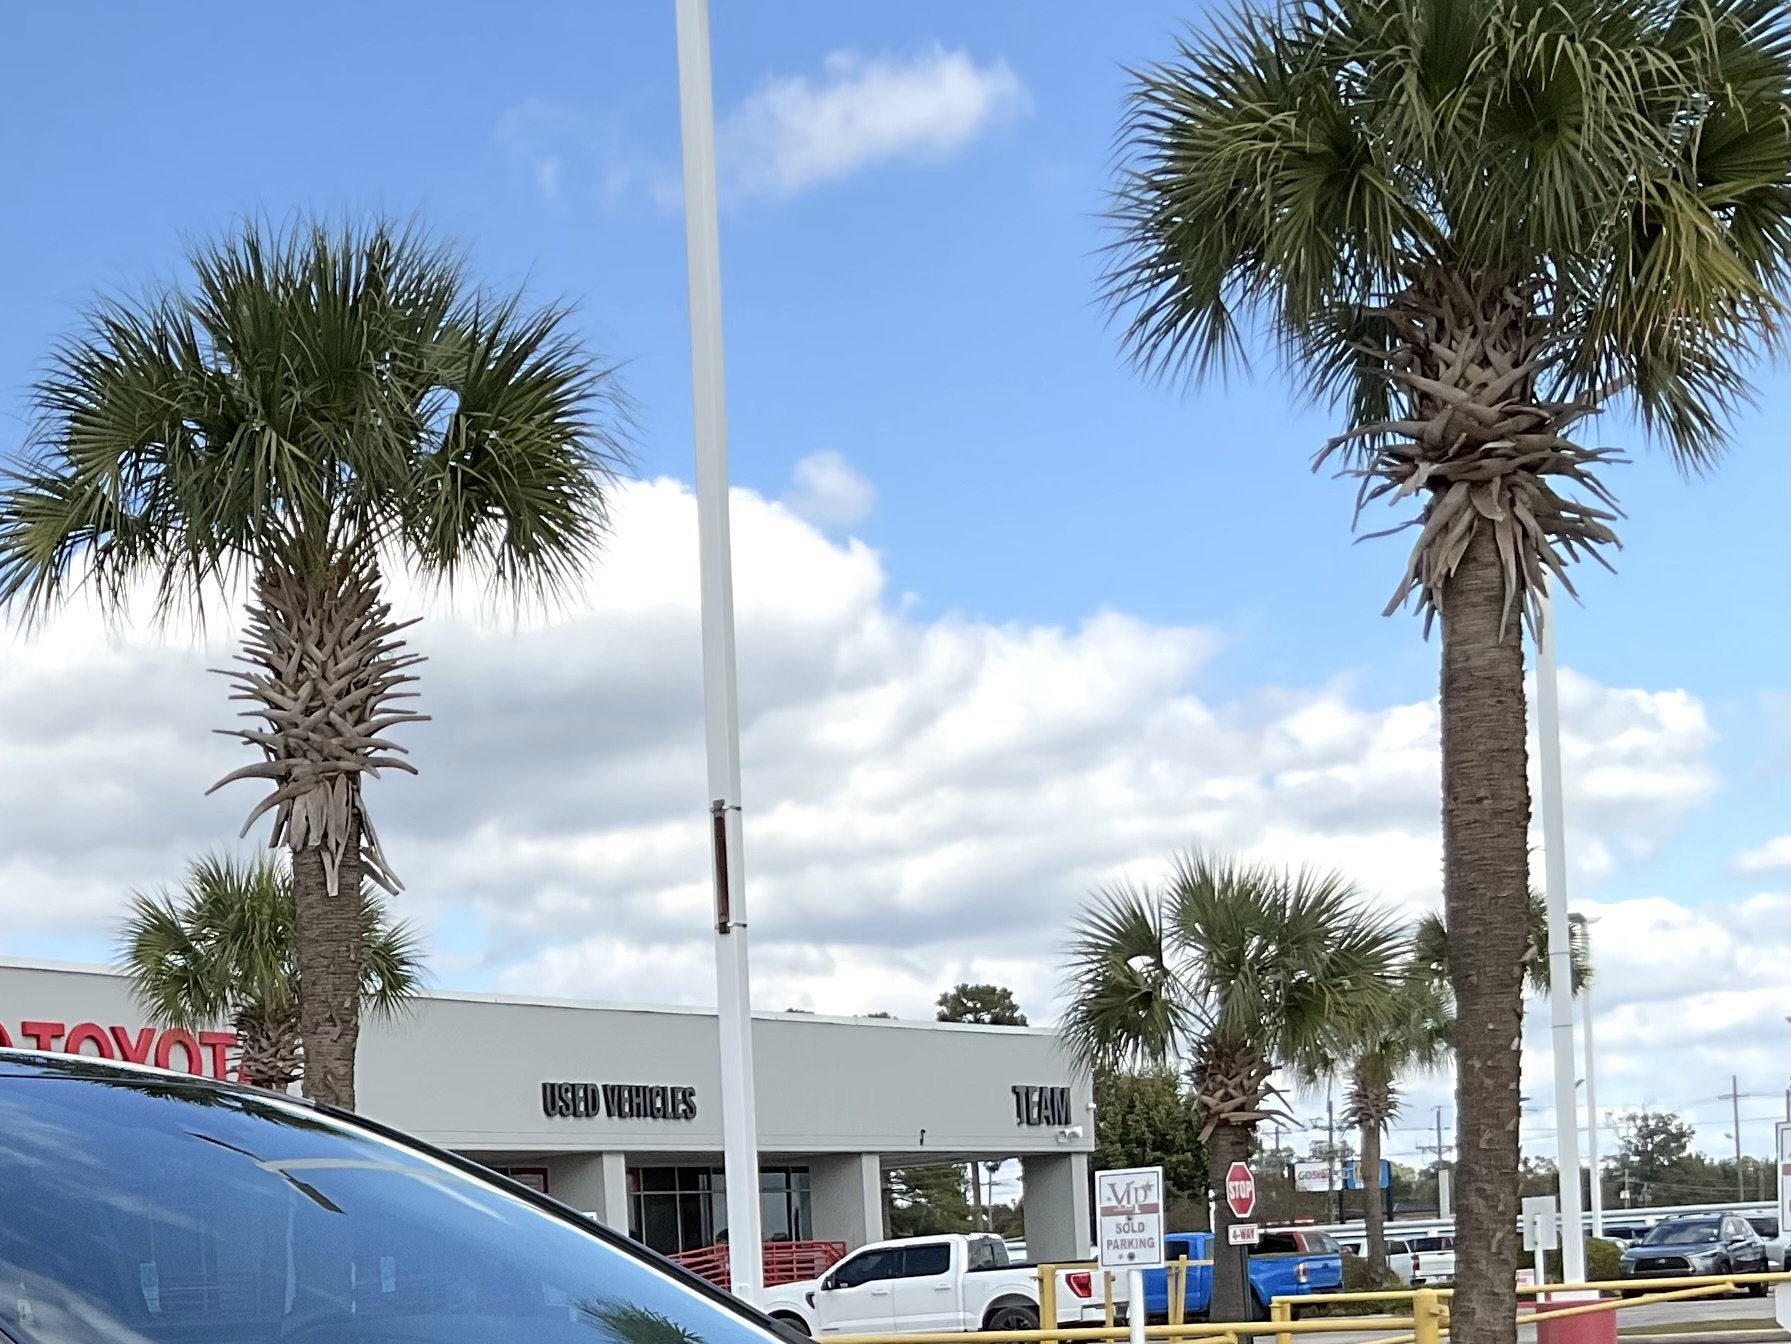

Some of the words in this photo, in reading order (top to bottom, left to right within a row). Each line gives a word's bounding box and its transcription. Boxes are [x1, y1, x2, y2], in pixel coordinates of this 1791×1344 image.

[21, 1021, 251, 1084] TOYOT
[542, 1082, 600, 1117] USED
[602, 1084, 697, 1119] VEHICLES
[1012, 1085, 1072, 1126] TEAM
[1228, 1180, 1252, 1199] STOP
[1115, 1222, 1145, 1234] SOLD
[1232, 1228, 1255, 1241] 4-WAY
[1107, 1237, 1155, 1250] PARKING
